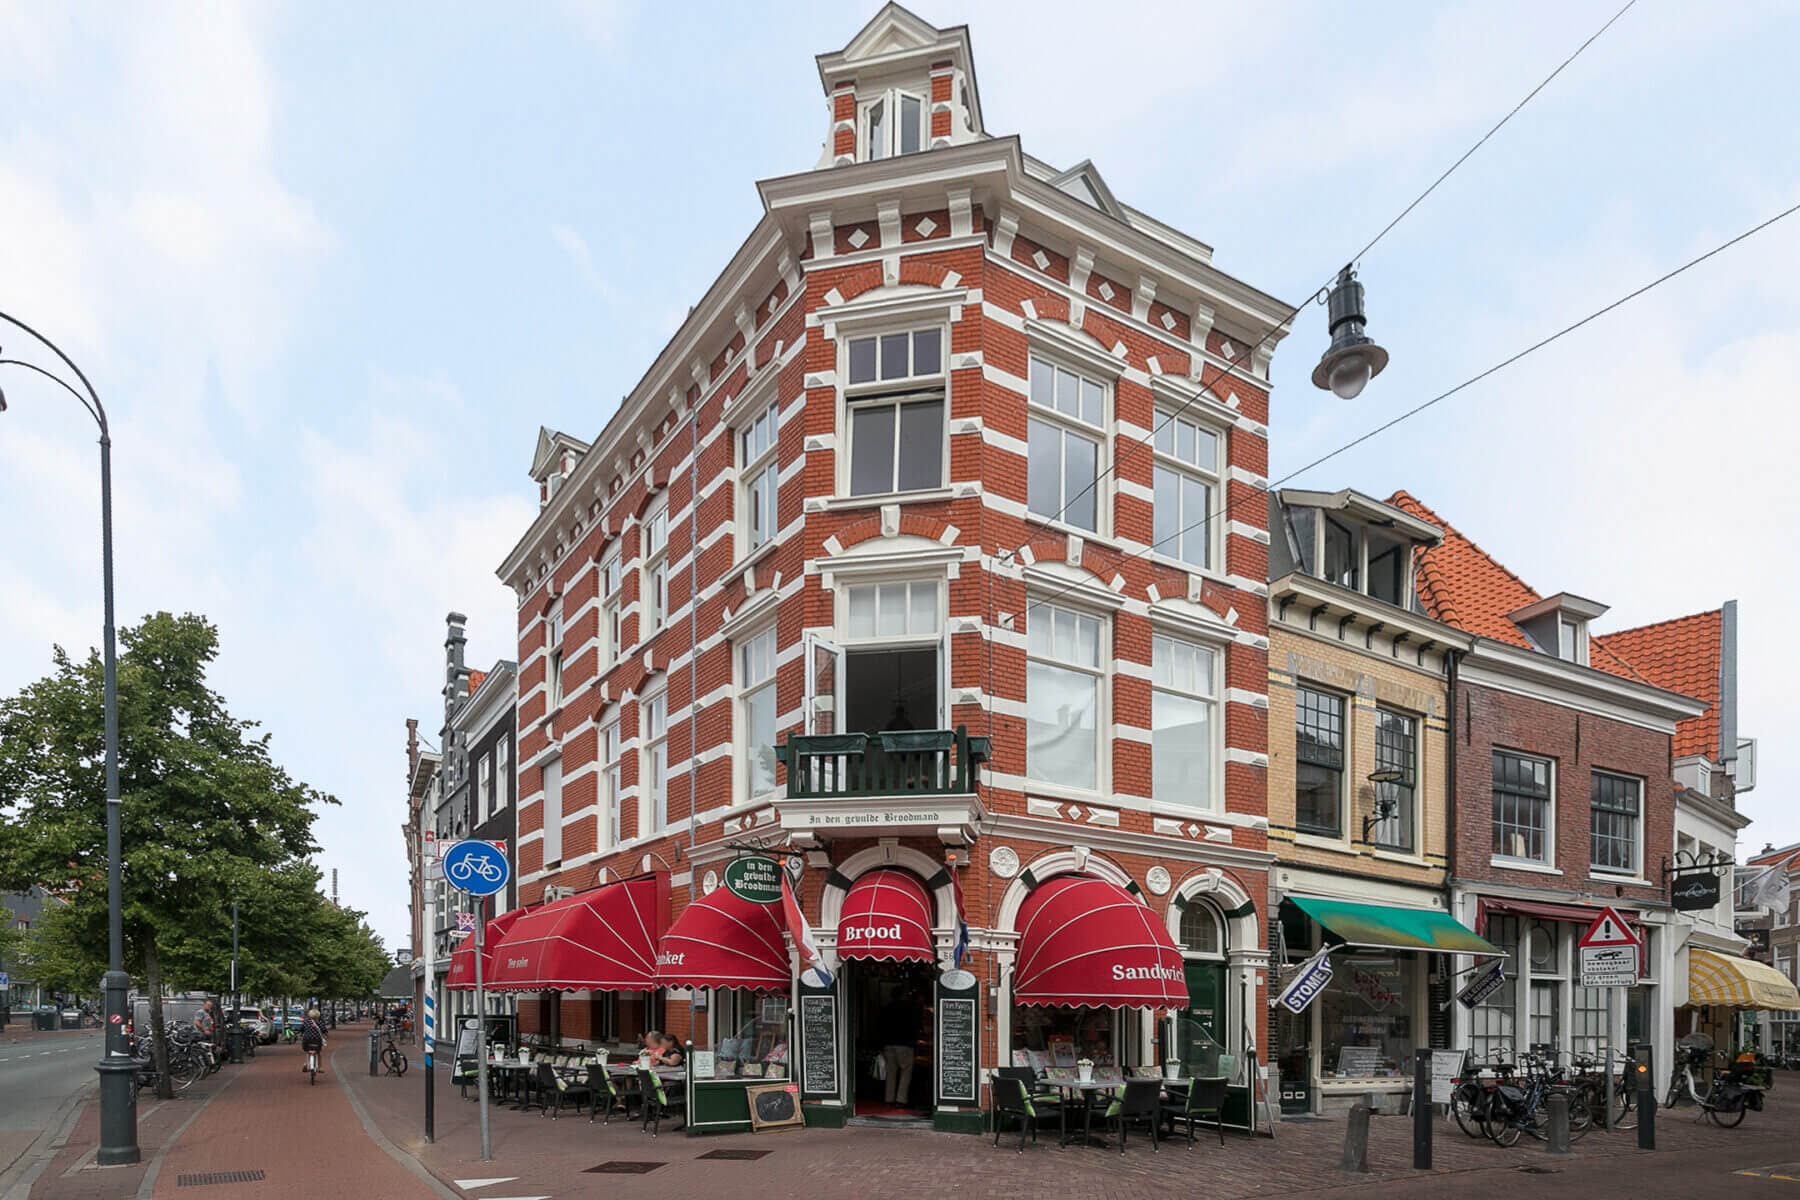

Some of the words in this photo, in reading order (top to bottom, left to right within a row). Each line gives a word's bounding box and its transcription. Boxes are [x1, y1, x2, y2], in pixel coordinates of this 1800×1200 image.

[809, 815, 821, 824] In
[825, 815, 841, 823] den
[845, 814, 879, 824] gevulde
[884, 812, 940, 822] Broodmand
[746, 861, 756, 870] in
[758, 862, 773, 871] den
[743, 871, 777, 882] gevulde
[735, 879, 781, 892] Broodman
[845, 923, 902, 941] Brood
